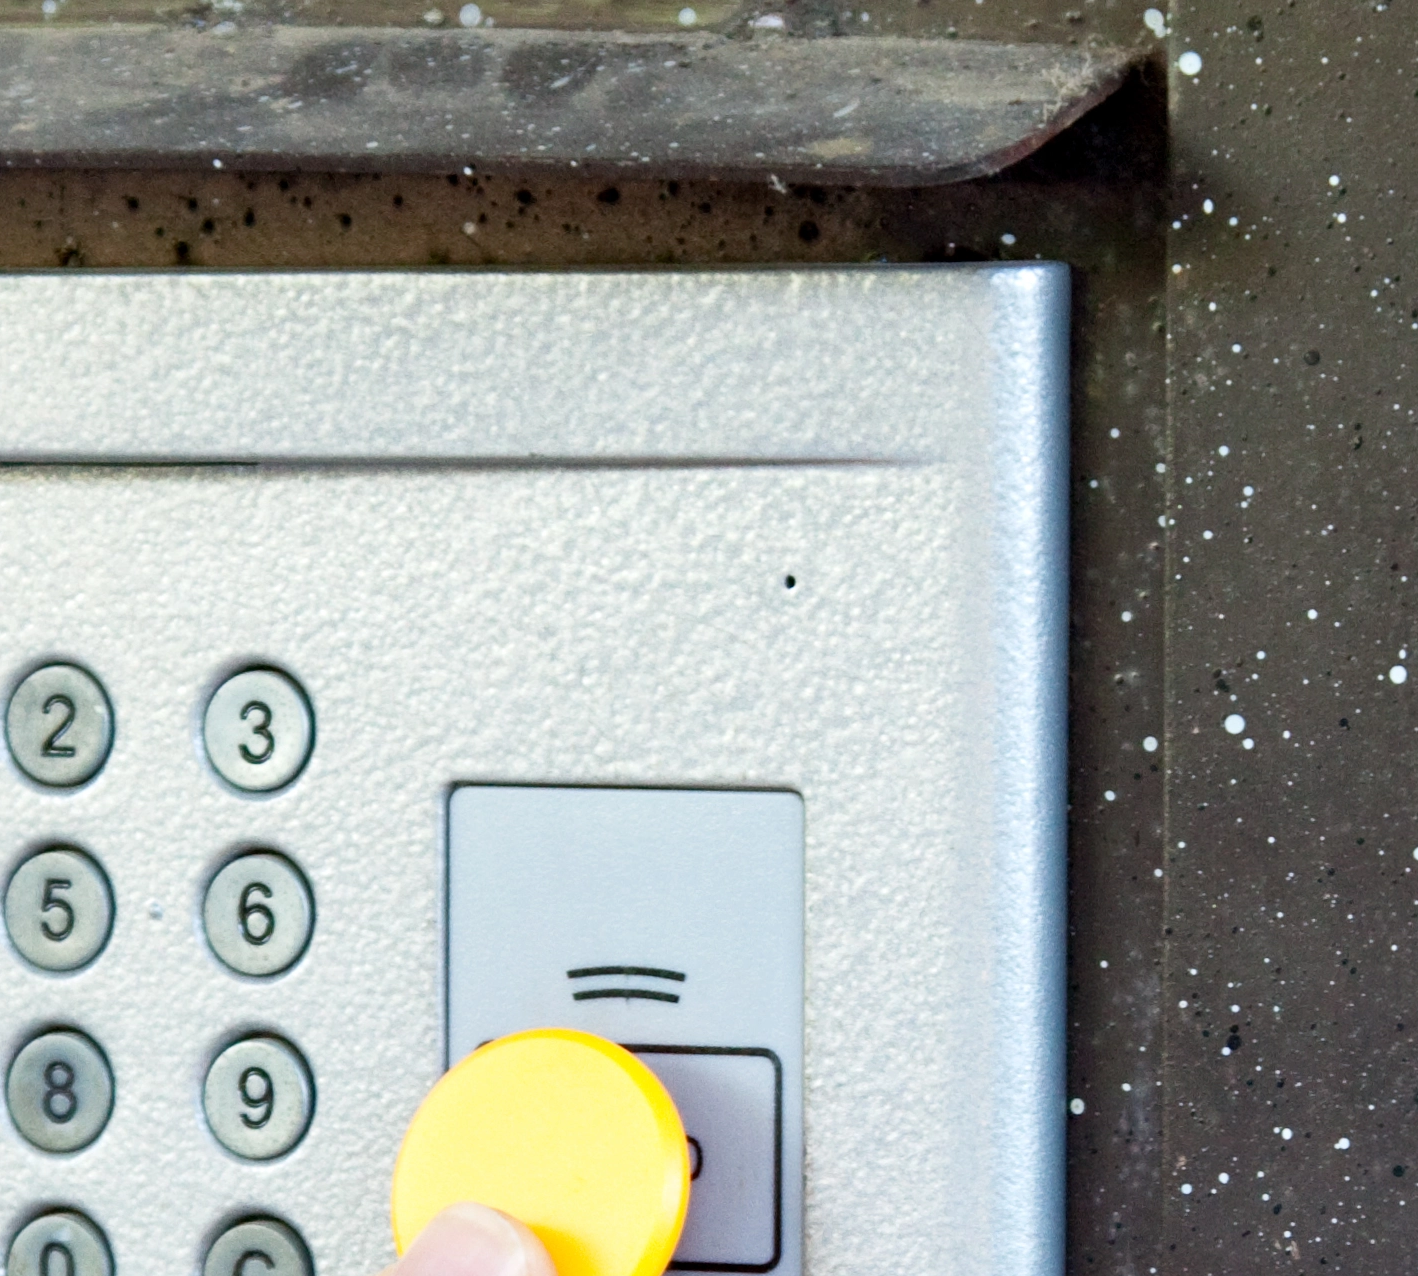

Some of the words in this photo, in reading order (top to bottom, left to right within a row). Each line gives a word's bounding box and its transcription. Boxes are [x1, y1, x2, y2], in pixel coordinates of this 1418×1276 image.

[40, 693, 77, 758] 2
[237, 701, 275, 765] 3
[39, 878, 75, 942] 5
[238, 881, 276, 946] 6
[41, 1060, 78, 1125] 8
[238, 1065, 275, 1129] 9
